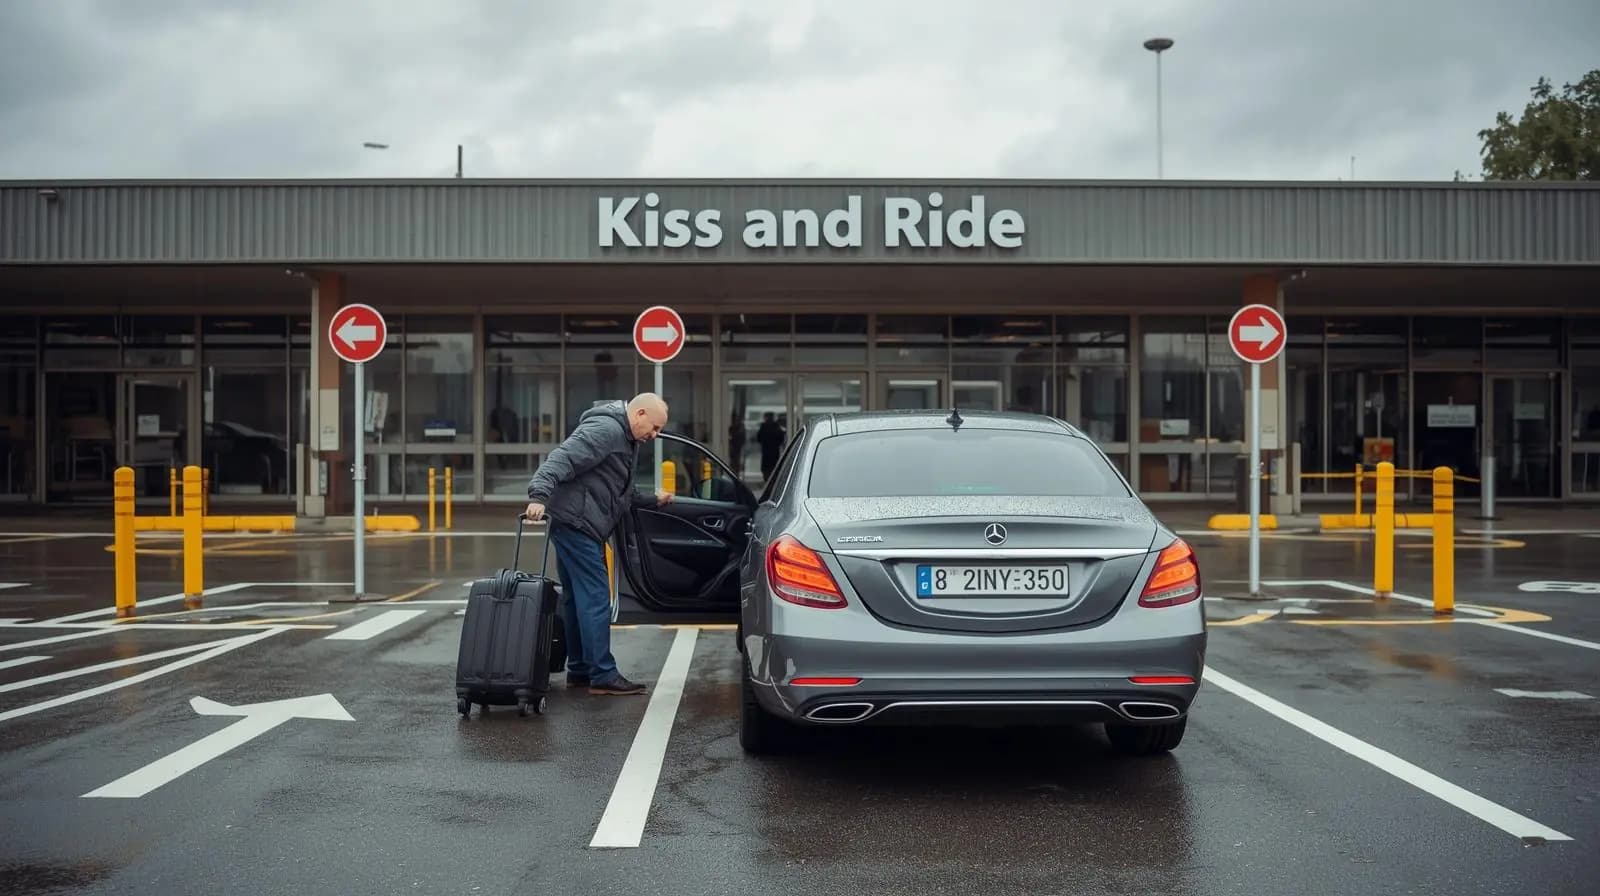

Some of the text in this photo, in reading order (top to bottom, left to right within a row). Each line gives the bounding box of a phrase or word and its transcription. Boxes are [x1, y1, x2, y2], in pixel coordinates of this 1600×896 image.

[598, 192, 1025, 248] Kiss and Ride
[935, 569, 947, 590] 8
